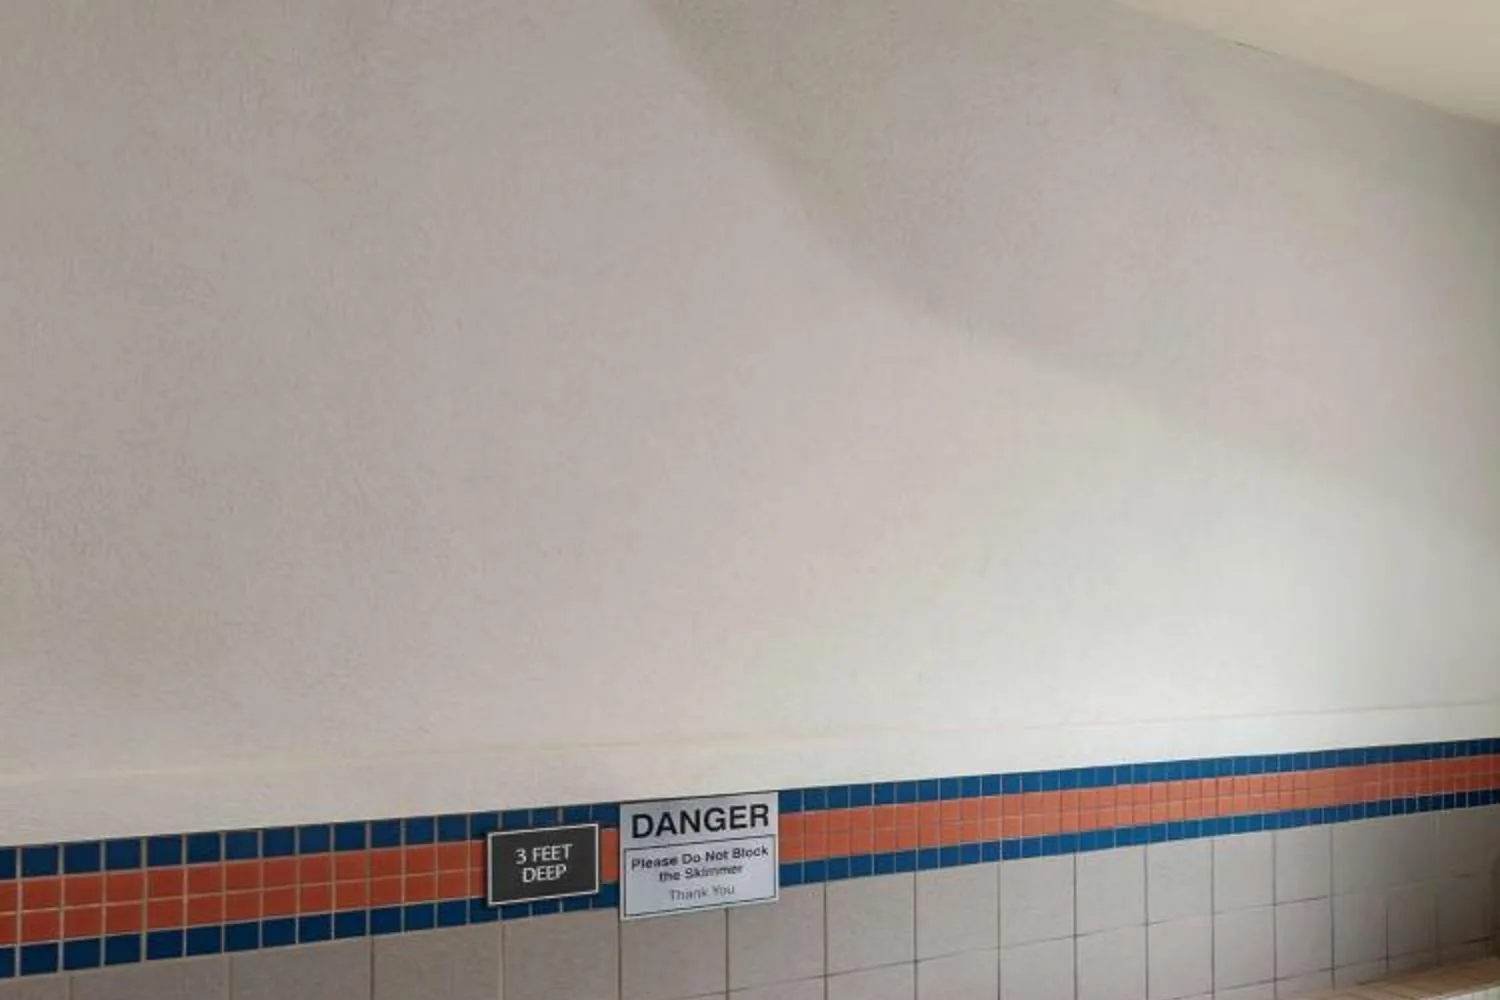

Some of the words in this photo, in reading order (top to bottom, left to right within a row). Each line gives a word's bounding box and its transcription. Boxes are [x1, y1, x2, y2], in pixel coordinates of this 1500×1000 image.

[632, 803, 770, 839] DANGER
[515, 847, 528, 865] 3
[532, 843, 574, 862] FEET
[631, 855, 679, 870] Please
[682, 852, 701, 865] Do
[705, 850, 729, 862] Not
[732, 845, 769, 858] Block
[523, 863, 567, 883] DEEP
[659, 869, 681, 882] the
[684, 865, 743, 879] Skimmer
[670, 886, 709, 901] Thank
[711, 883, 735, 897] You
